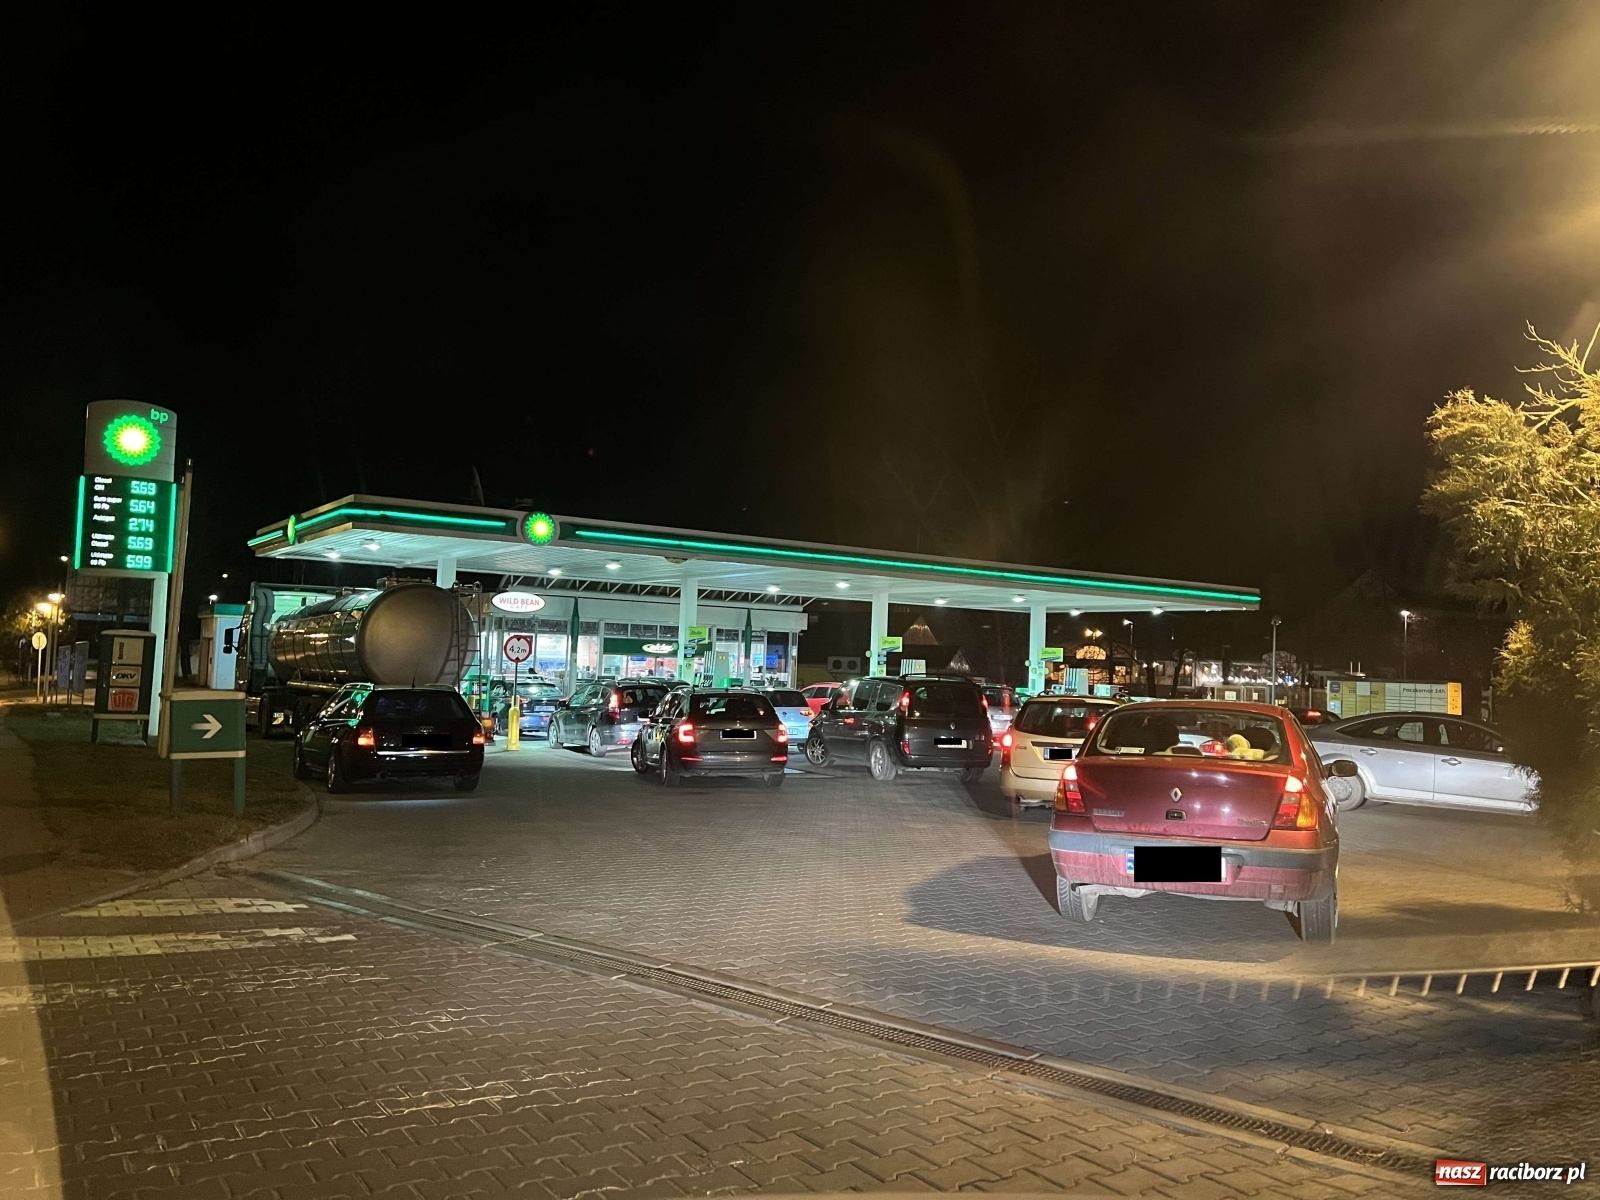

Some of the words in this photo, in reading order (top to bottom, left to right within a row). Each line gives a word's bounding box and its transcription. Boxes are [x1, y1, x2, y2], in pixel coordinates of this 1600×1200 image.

[150, 408, 169, 423] bp
[499, 597, 519, 605] WILD
[520, 598, 540, 606] BEAN
[116, 672, 137, 680] DKV
